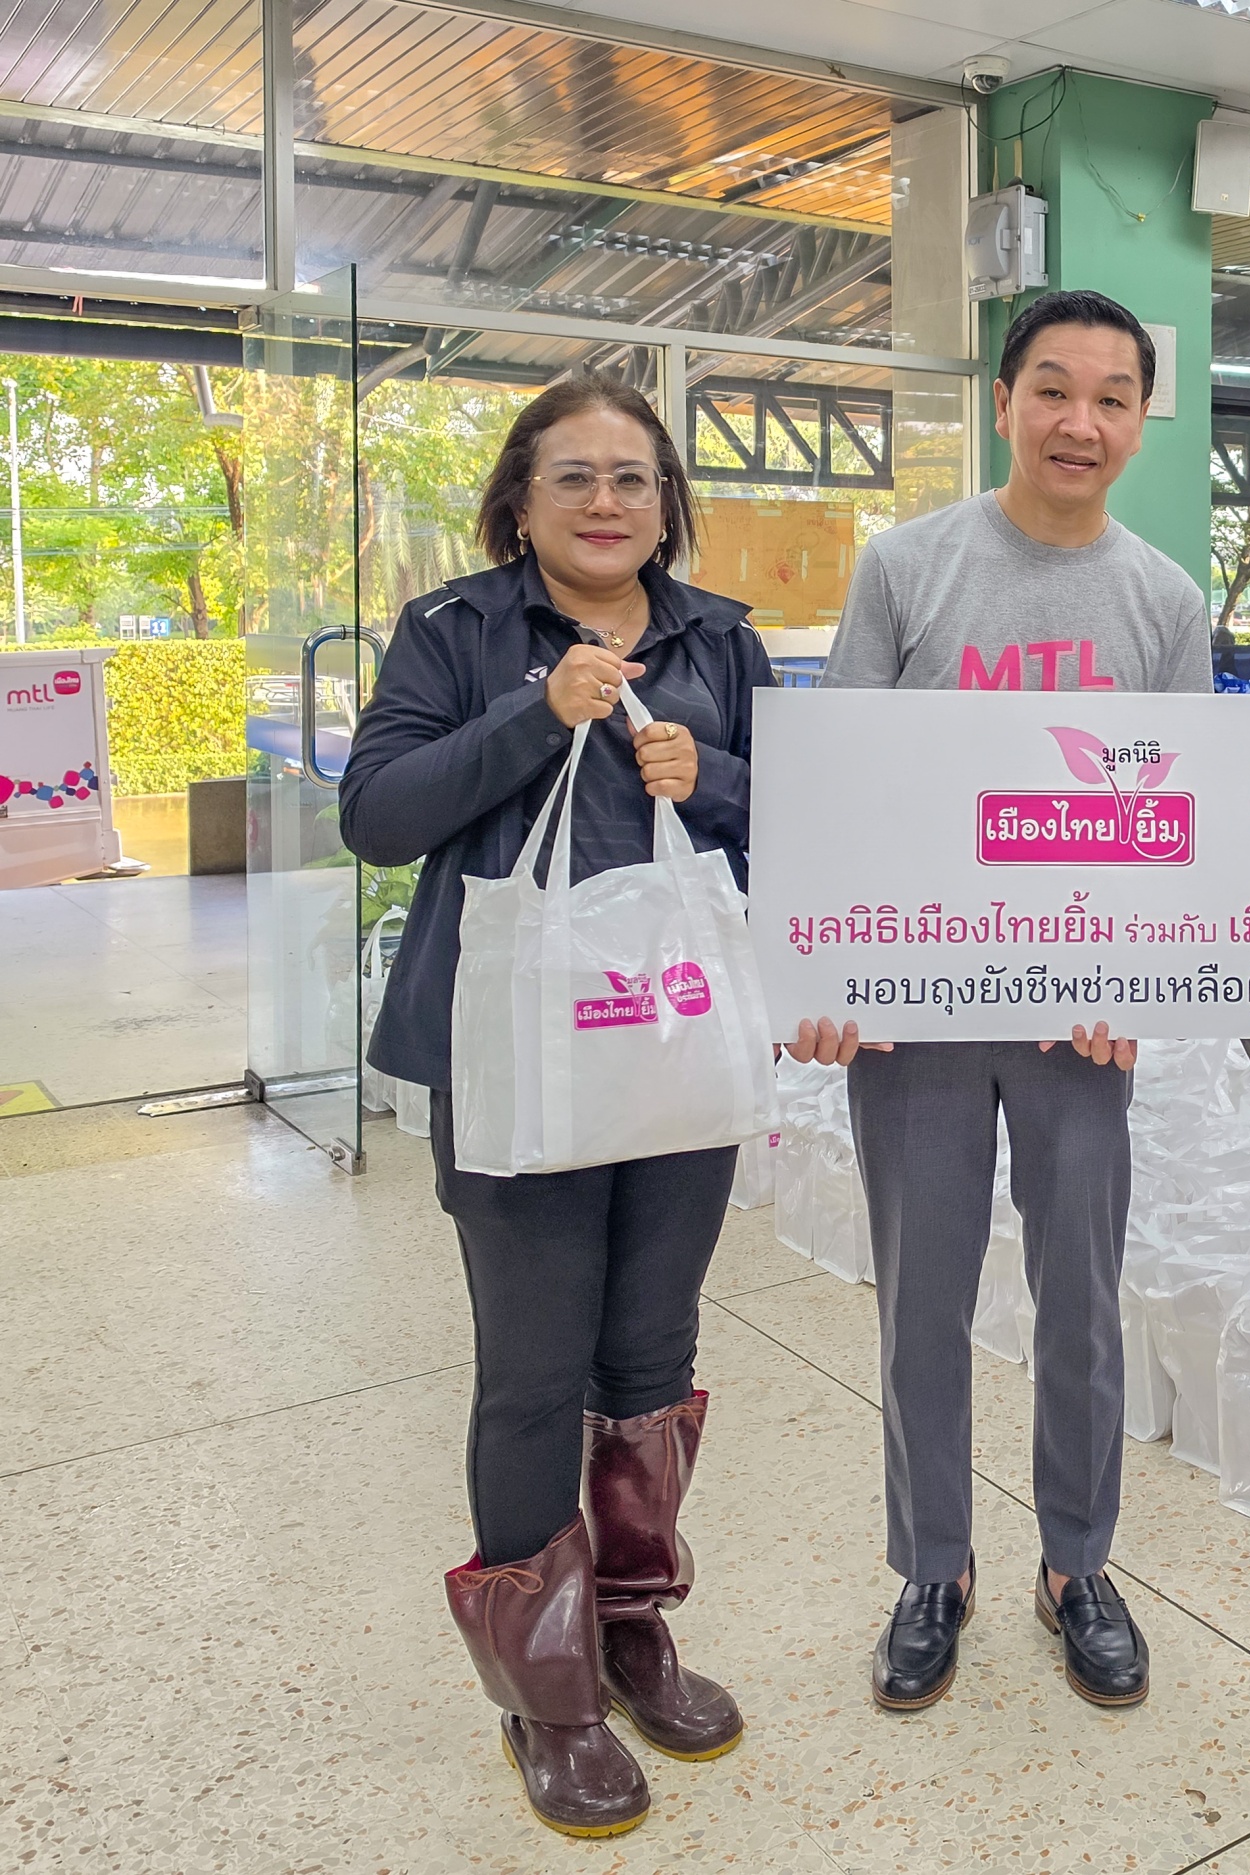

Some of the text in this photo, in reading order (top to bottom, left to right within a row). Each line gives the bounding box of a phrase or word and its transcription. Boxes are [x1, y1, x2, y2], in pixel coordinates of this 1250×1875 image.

[151, 621, 167, 634] 11
[957, 640, 1115, 691] MTL
[7, 684, 55, 705] mtl
[1102, 740, 1161, 772] มูลนิธิ
[788, 891, 1115, 957] มูลนิธิเมืองไทยยิ้ม
[1124, 913, 1217, 944] ร่วมกับ
